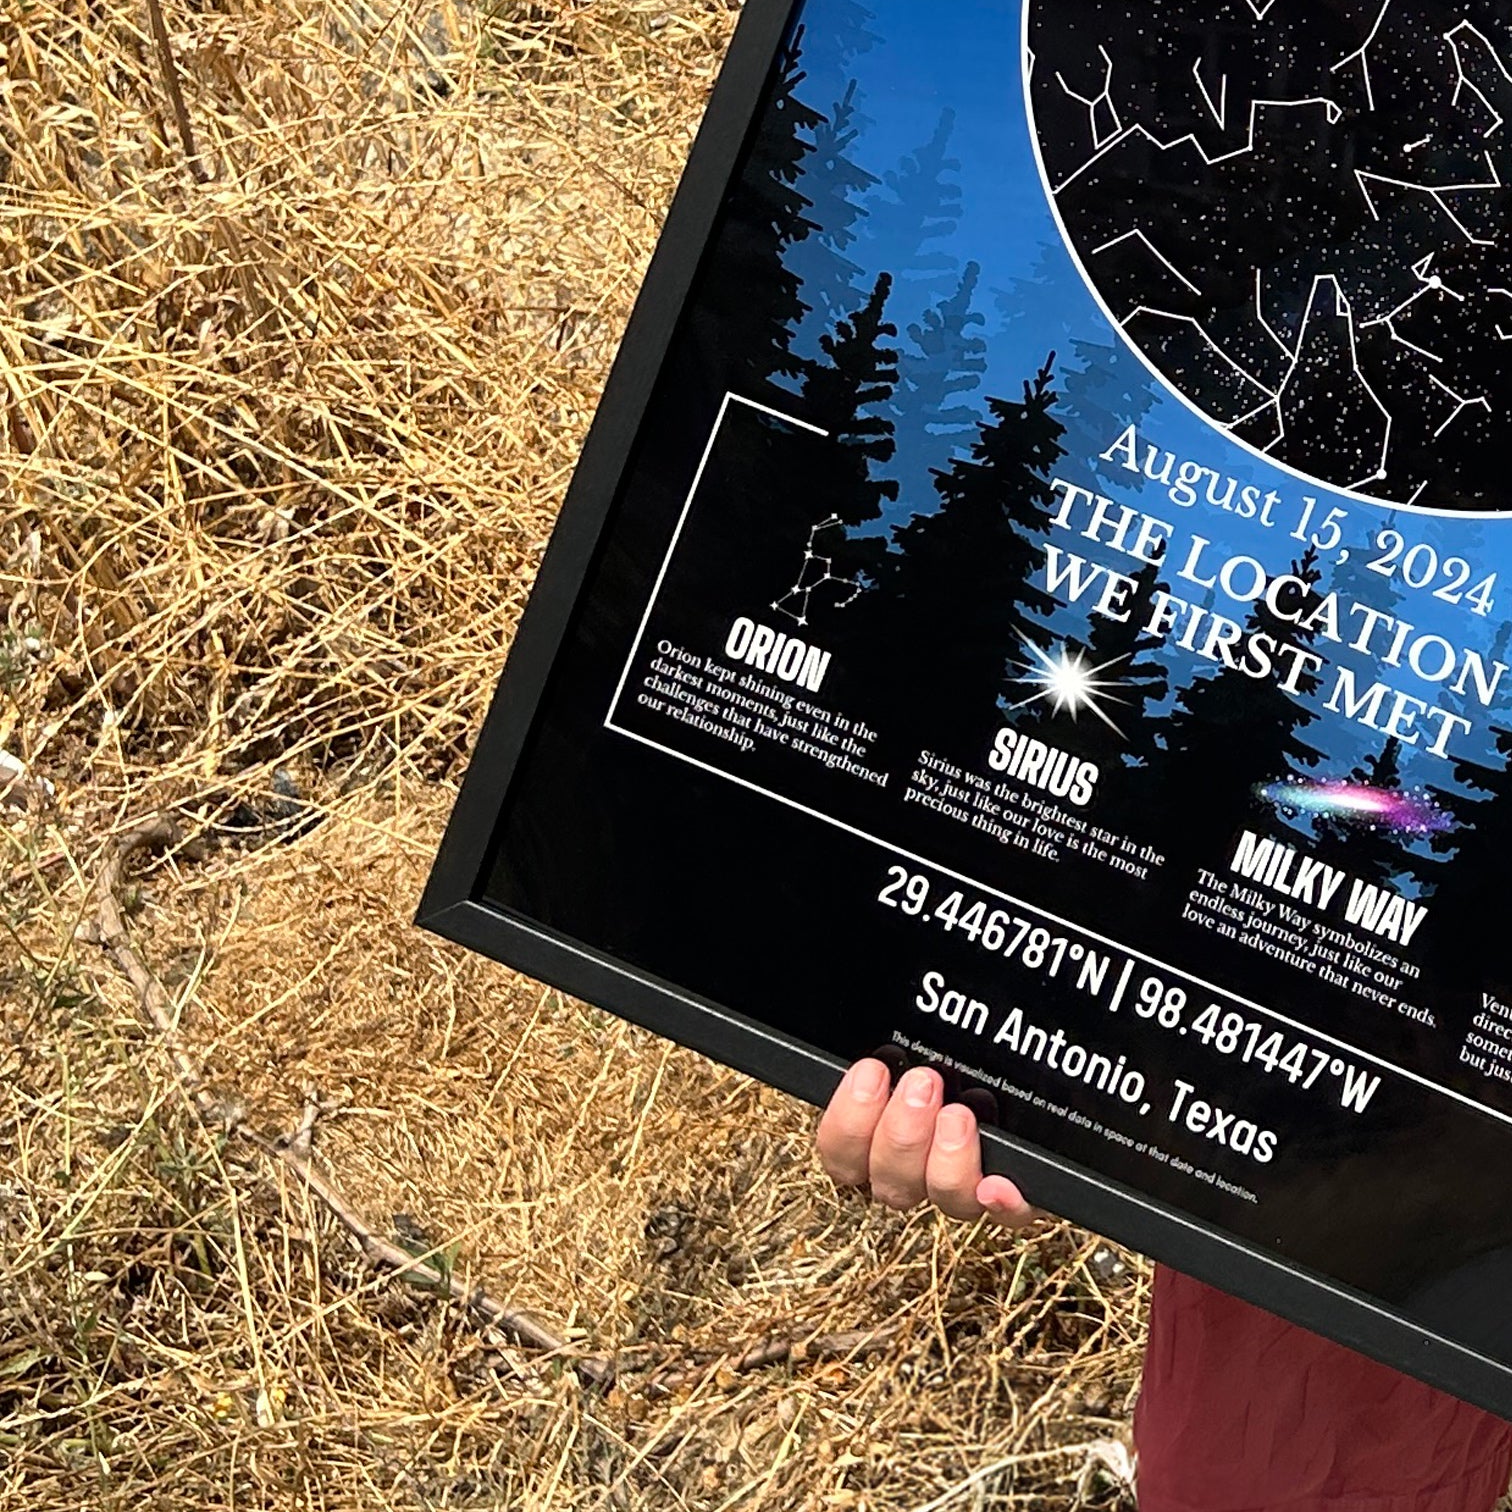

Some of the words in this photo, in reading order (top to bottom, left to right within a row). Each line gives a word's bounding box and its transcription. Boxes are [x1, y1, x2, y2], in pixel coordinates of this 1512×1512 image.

[1099, 424, 1280, 526] August
[1290, 497, 1348, 565] 15,
[1366, 530, 1495, 616] 2024
[1049, 478, 1173, 567] THE
[1177, 535, 1508, 706] LOCATION
[657, 639, 701, 669] Orion
[703, 657, 736, 683] kept
[738, 674, 795, 710] shining
[795, 700, 831, 723] even
[833, 712, 850, 731] in
[852, 722, 877, 742] the
[725, 616, 831, 693] ORION
[1043, 543, 1138, 622] WE
[1142, 590, 1322, 695] FIRST
[1323, 666, 1471, 759] MET
[637, 693, 666, 711] our
[665, 705, 755, 751] relationship.
[643, 675, 719, 715] challenges
[722, 706, 752, 729] that
[753, 718, 789, 744] have
[790, 737, 889, 787] strengthened
[650, 657, 703, 689] darkest
[705, 682, 778, 723] moments,
[777, 710, 809, 733] just
[810, 722, 839, 745] like
[840, 737, 866, 758] the
[917, 750, 962, 779] Sirius
[965, 771, 991, 792] was
[993, 783, 1019, 803] the
[1021, 792, 1087, 833] brightest
[1089, 826, 1119, 846] star
[1119, 836, 1137, 855] in
[1139, 845, 1165, 866] the
[988, 727, 1098, 806] SIRIUS
[903, 787, 969, 823] precious
[971, 813, 1012, 844] thing
[1012, 830, 1029, 849] in
[1031, 837, 1059, 862] life.
[911, 768, 939, 792] sky,
[938, 779, 970, 803] just
[972, 791, 1000, 815] like
[1002, 809, 1030, 828] our
[1031, 817, 1065, 843] love
[1066, 833, 1079, 850] is
[1082, 841, 1107, 862] the
[1109, 855, 1147, 880] most
[1189, 890, 1245, 922] endless
[1242, 911, 1309, 953] journey,
[1308, 943, 1340, 964] just
[1342, 952, 1371, 977] like
[1373, 971, 1403, 990] our
[1197, 868, 1228, 893] The
[1229, 883, 1276, 917] Milky
[1279, 903, 1311, 933] Way
[1312, 923, 1398, 968] symbolizes
[1399, 961, 1420, 979] an
[1230, 830, 1345, 910] MILKY
[1344, 878, 1428, 946] WAY
[878, 865, 1110, 995] 29.446781°N
[1135, 977, 1381, 1114] 98.481447°W
[1182, 902, 1215, 929] love
[1216, 922, 1236, 939] an
[1238, 931, 1316, 973] adventure
[1318, 964, 1349, 989] that
[1351, 981, 1396, 1008] never
[1397, 1002, 1435, 1028] ends.
[916, 971, 988, 1035] San
[993, 1008, 1150, 1115] Antonio,
[1168, 1079, 1277, 1163] Texas
[1459, 1045, 1486, 1070] but
[892, 1030, 910, 1047] This
[910, 1040, 943, 1062] design
[944, 1055, 953, 1067] is
[1001, 1079, 1033, 1101] based
[1032, 1096, 1046, 1108] on
[1046, 1102, 1068, 1117] real
[1067, 1110, 1092, 1129] data
[1093, 1122, 1103, 1134] in
[1103, 1128, 1134, 1147] space
[1135, 1142, 1148, 1153] at
[1148, 1146, 1169, 1163] that
[1169, 1156, 1194, 1174] date
[1194, 1169, 1216, 1184] and
[1215, 1175, 1257, 1204] location.
